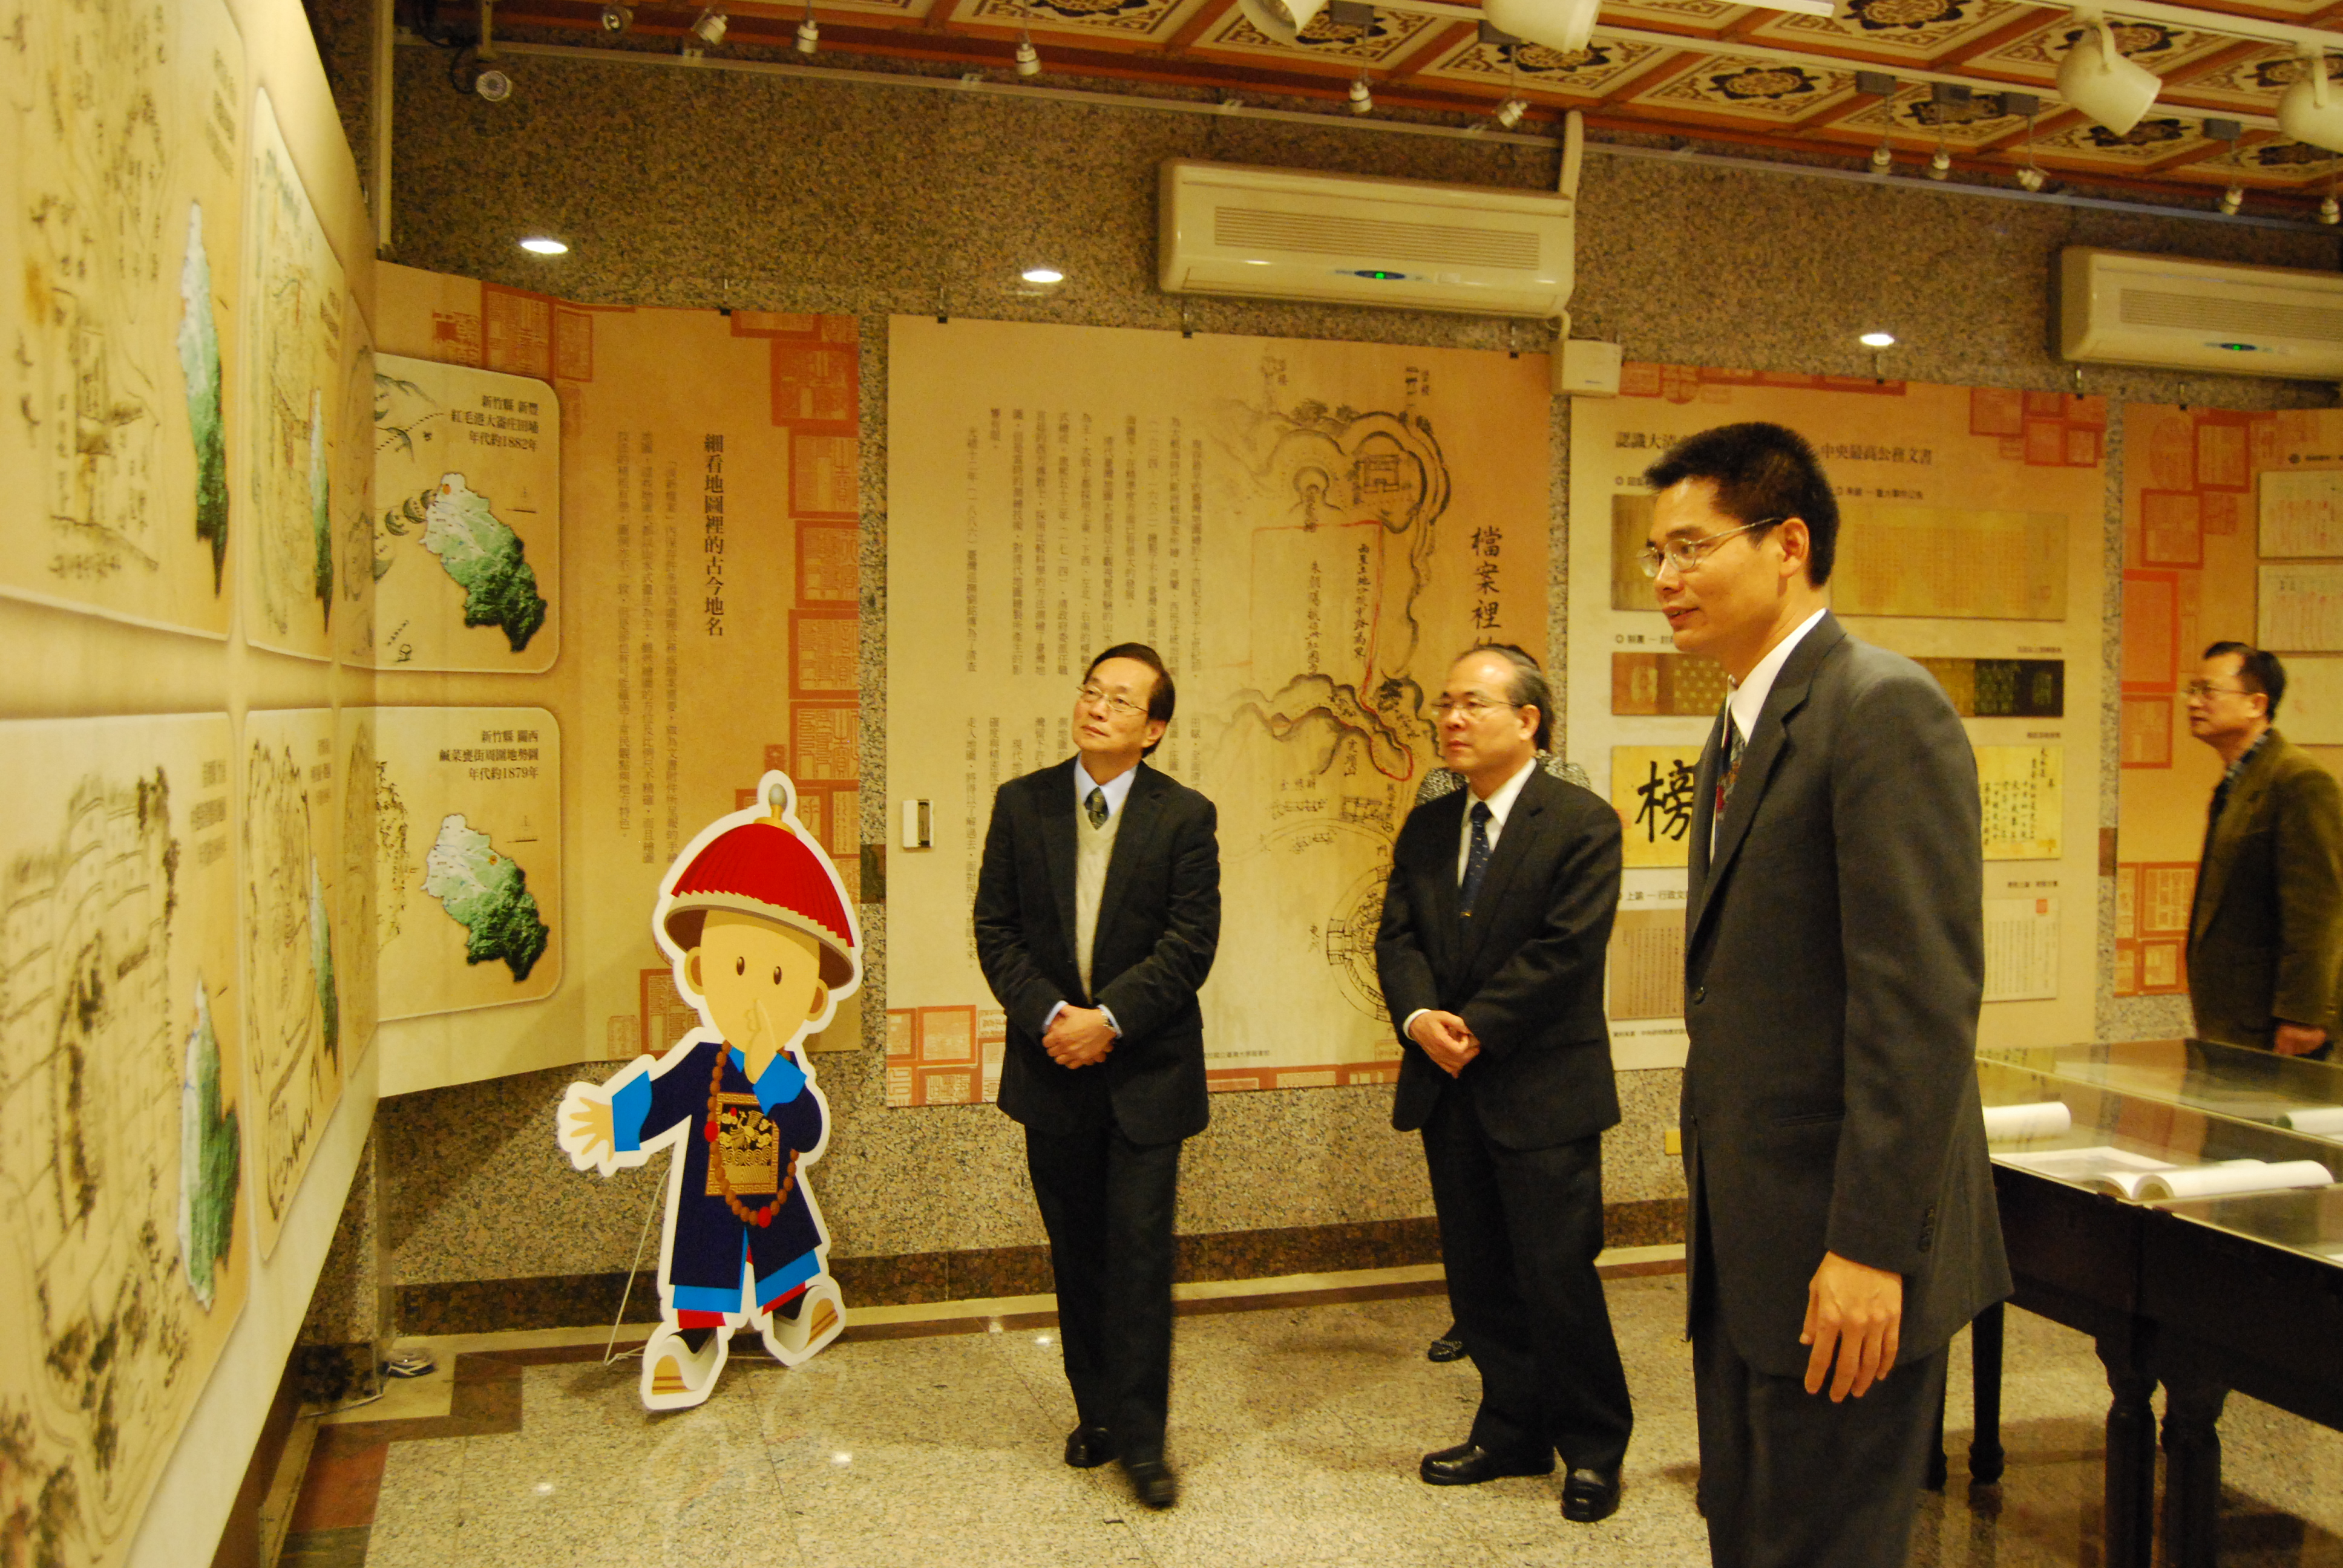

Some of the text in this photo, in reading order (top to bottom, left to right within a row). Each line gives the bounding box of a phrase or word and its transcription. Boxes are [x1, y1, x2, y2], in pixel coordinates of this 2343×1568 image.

[482, 395, 514, 411] 新竹縣
[470, 430, 538, 452] 年代約1882年
[1615, 431, 1687, 449] 認識大清
[704, 433, 724, 638] 細看地圖裡的古今地名
[1470, 525, 1502, 647] 檔案裡
[482, 730, 539, 743] 新竹縣 關西
[469, 766, 539, 780] 年代約1879年
[1635, 760, 1694, 843] 榜
